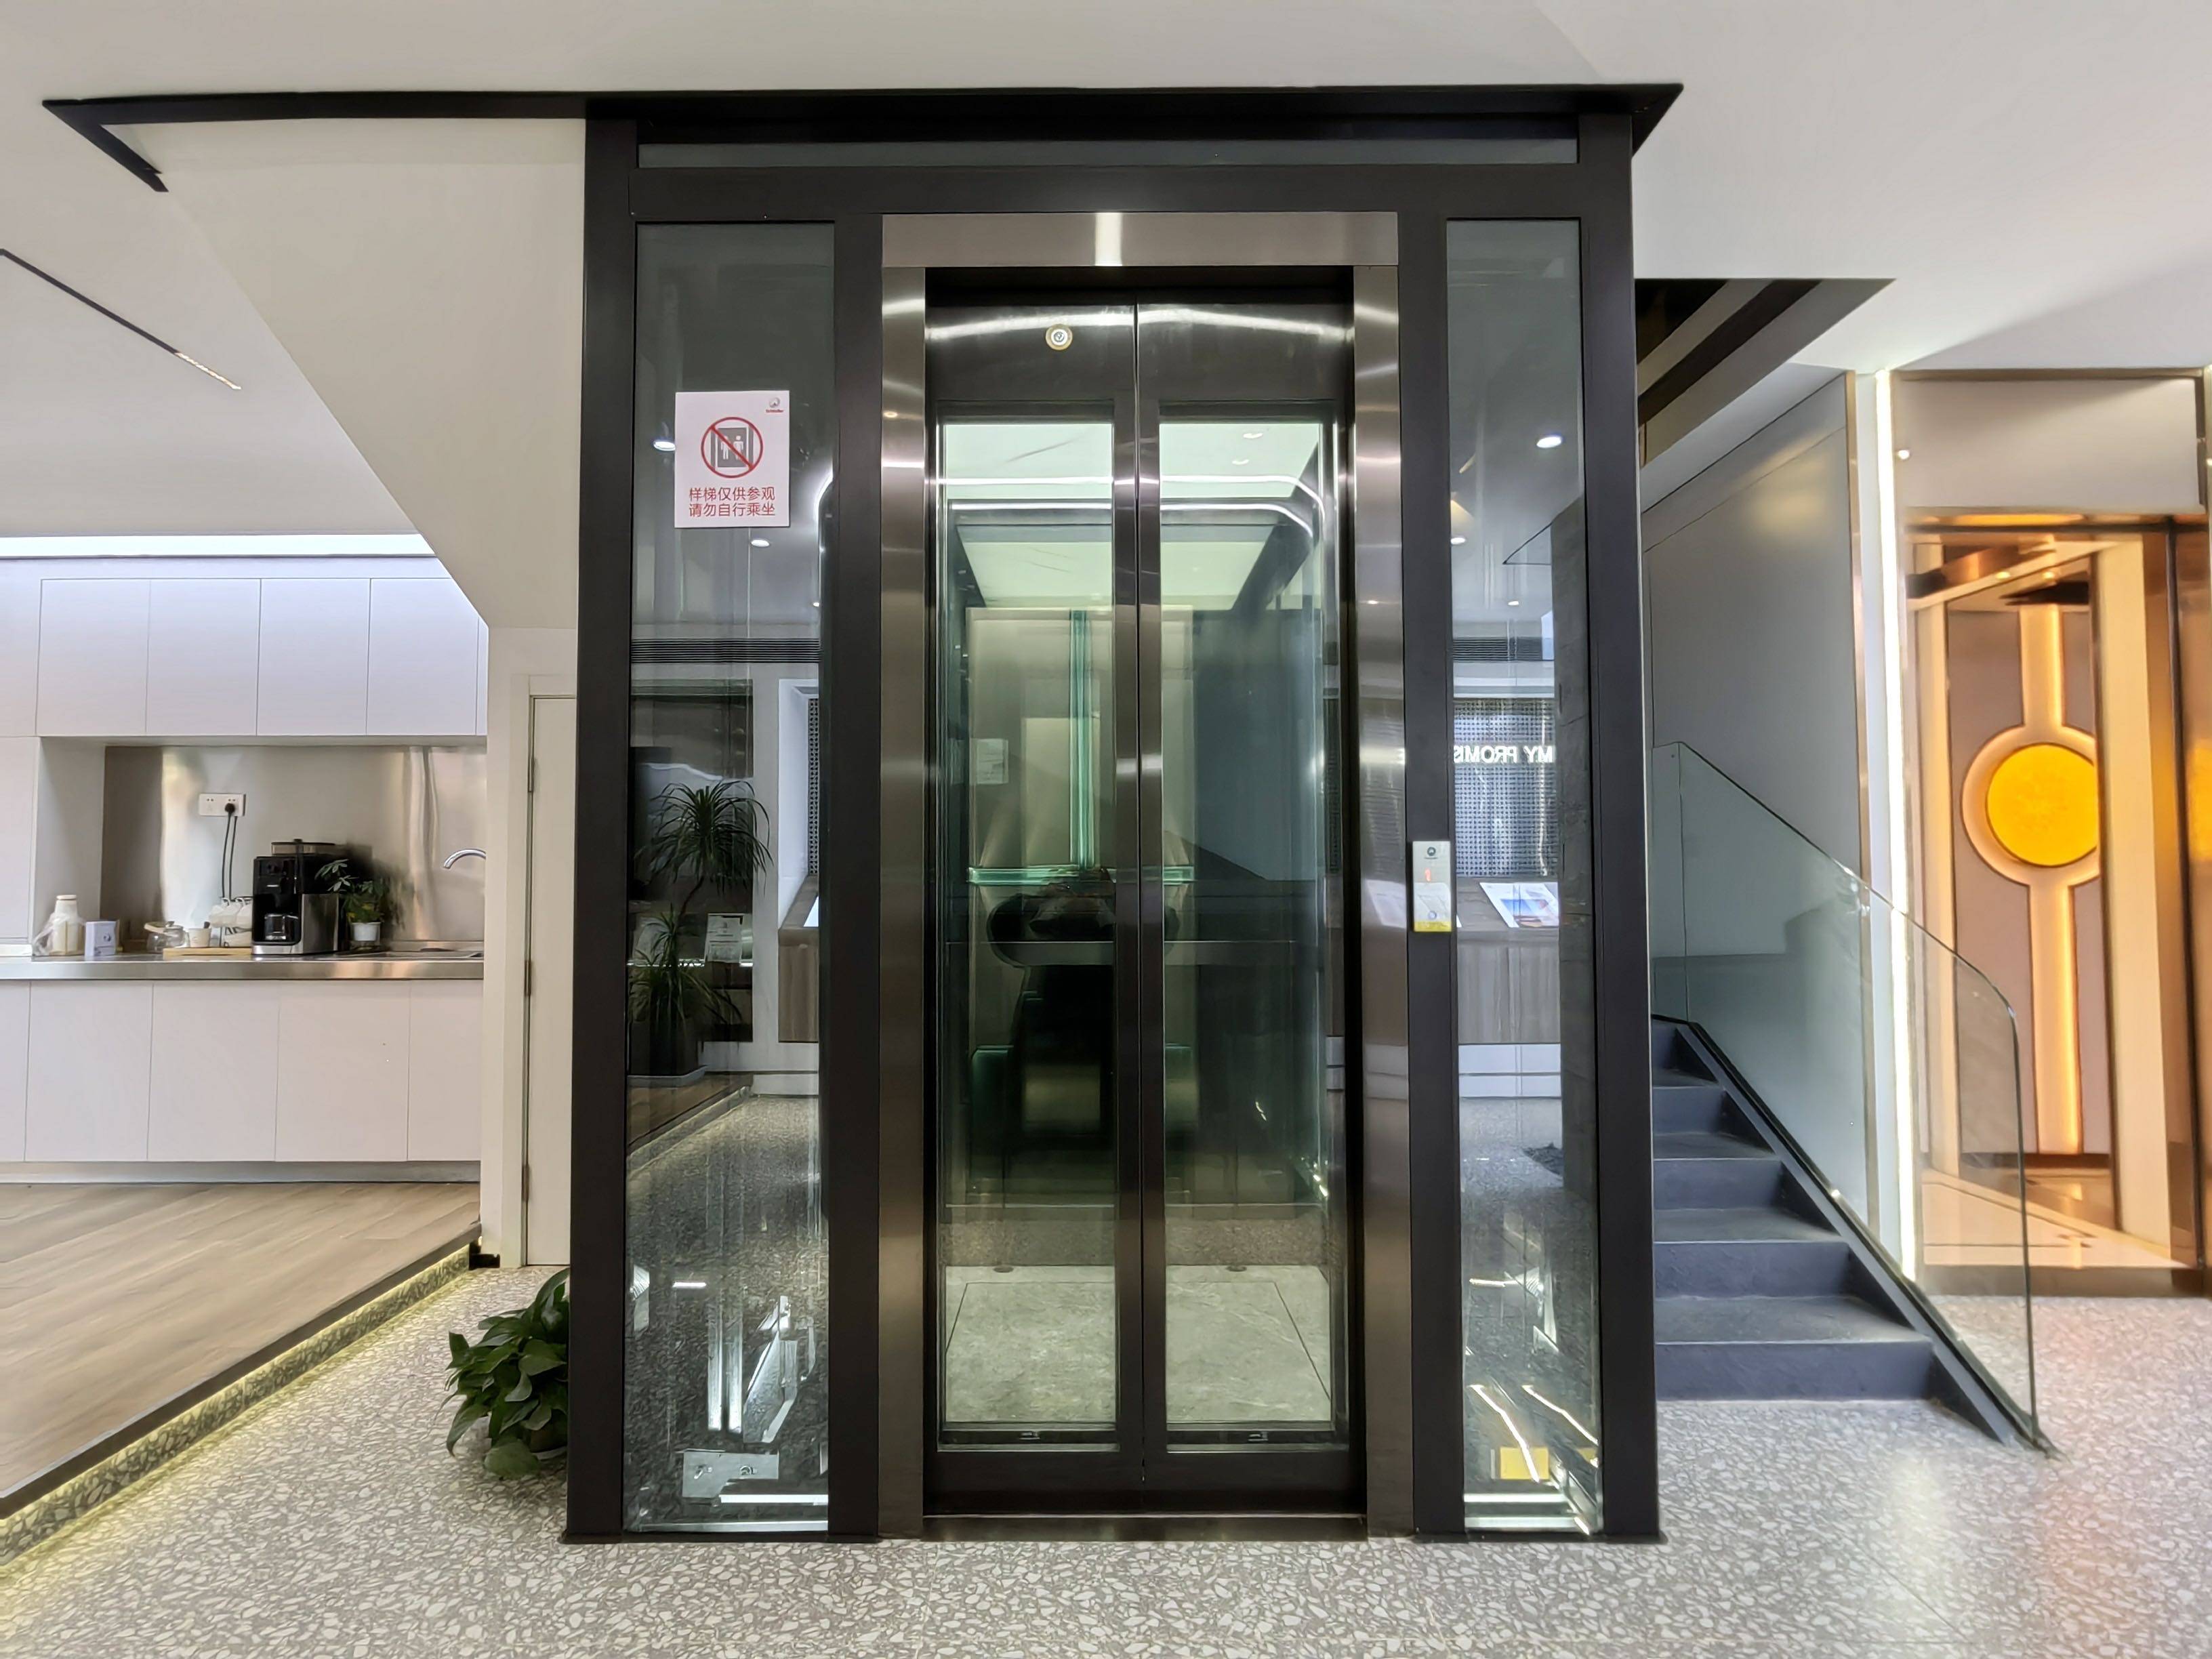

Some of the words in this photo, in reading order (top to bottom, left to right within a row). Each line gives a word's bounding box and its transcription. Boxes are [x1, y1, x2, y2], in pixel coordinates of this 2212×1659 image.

[689, 487, 776, 501] 样梯仅供参观
[689, 501, 776, 517] 请勿自行乘坐
